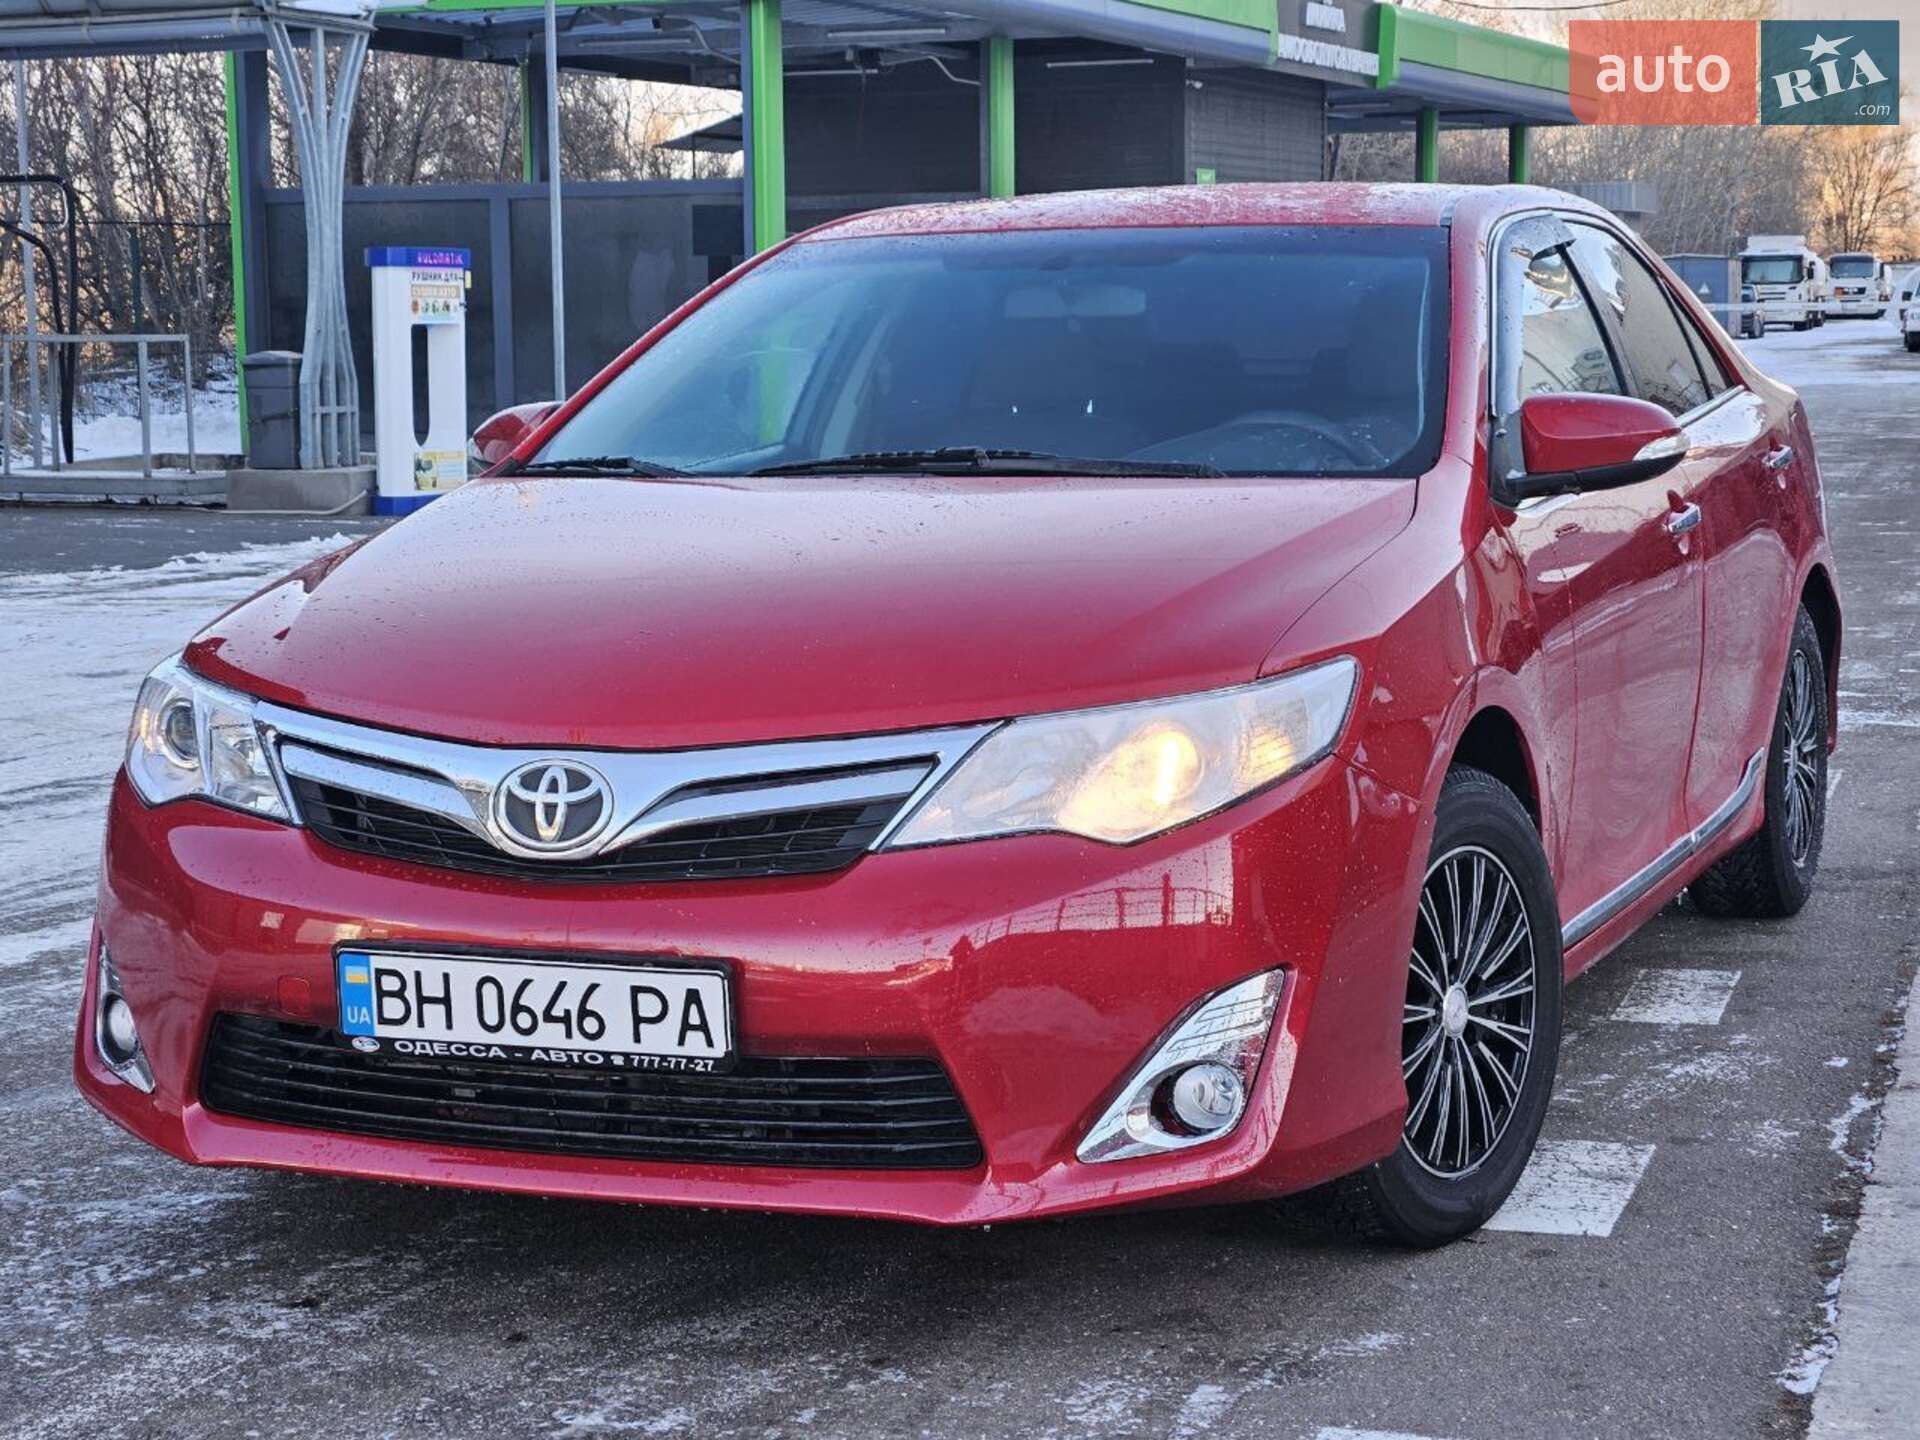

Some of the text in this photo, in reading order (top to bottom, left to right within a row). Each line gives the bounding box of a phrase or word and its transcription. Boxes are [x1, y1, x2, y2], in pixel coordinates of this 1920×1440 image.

[347, 967, 715, 1049] UA BH 0646 PA
[394, 1040, 508, 1058] ОДЕССА
[530, 1049, 605, 1065] АВТО
[629, 1055, 715, 1072] 777-77-27
